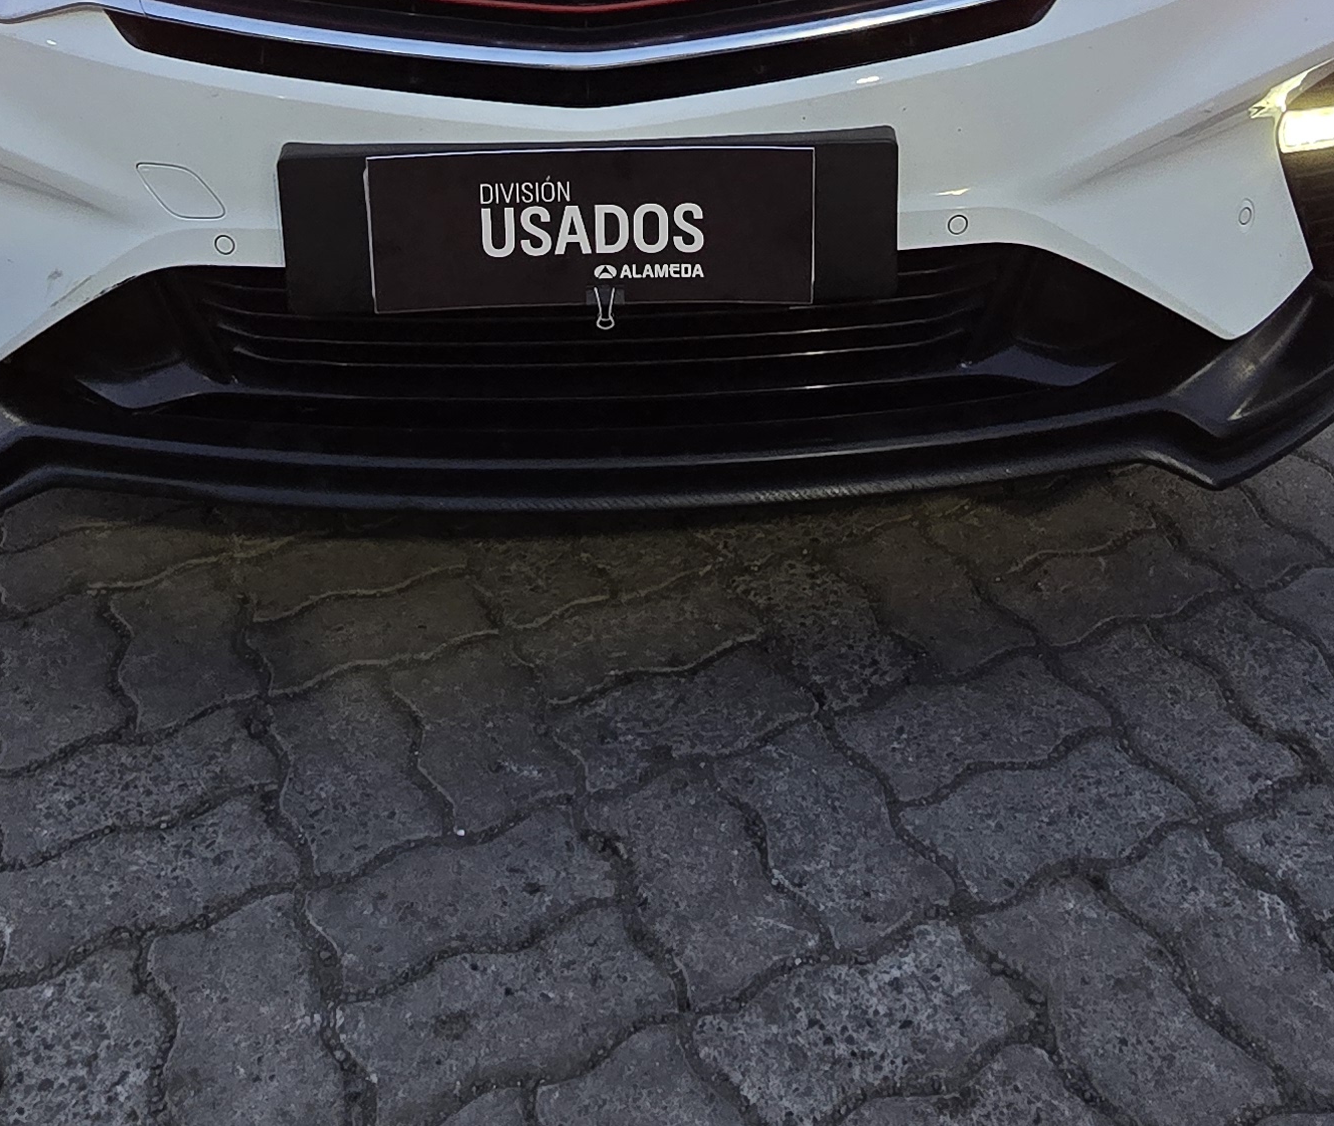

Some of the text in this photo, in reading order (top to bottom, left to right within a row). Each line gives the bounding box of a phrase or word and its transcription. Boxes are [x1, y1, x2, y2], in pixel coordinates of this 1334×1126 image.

[479, 175, 571, 205] DIVISIÓN
[480, 202, 705, 258] USADOS
[619, 263, 704, 279] ALAMEDA
